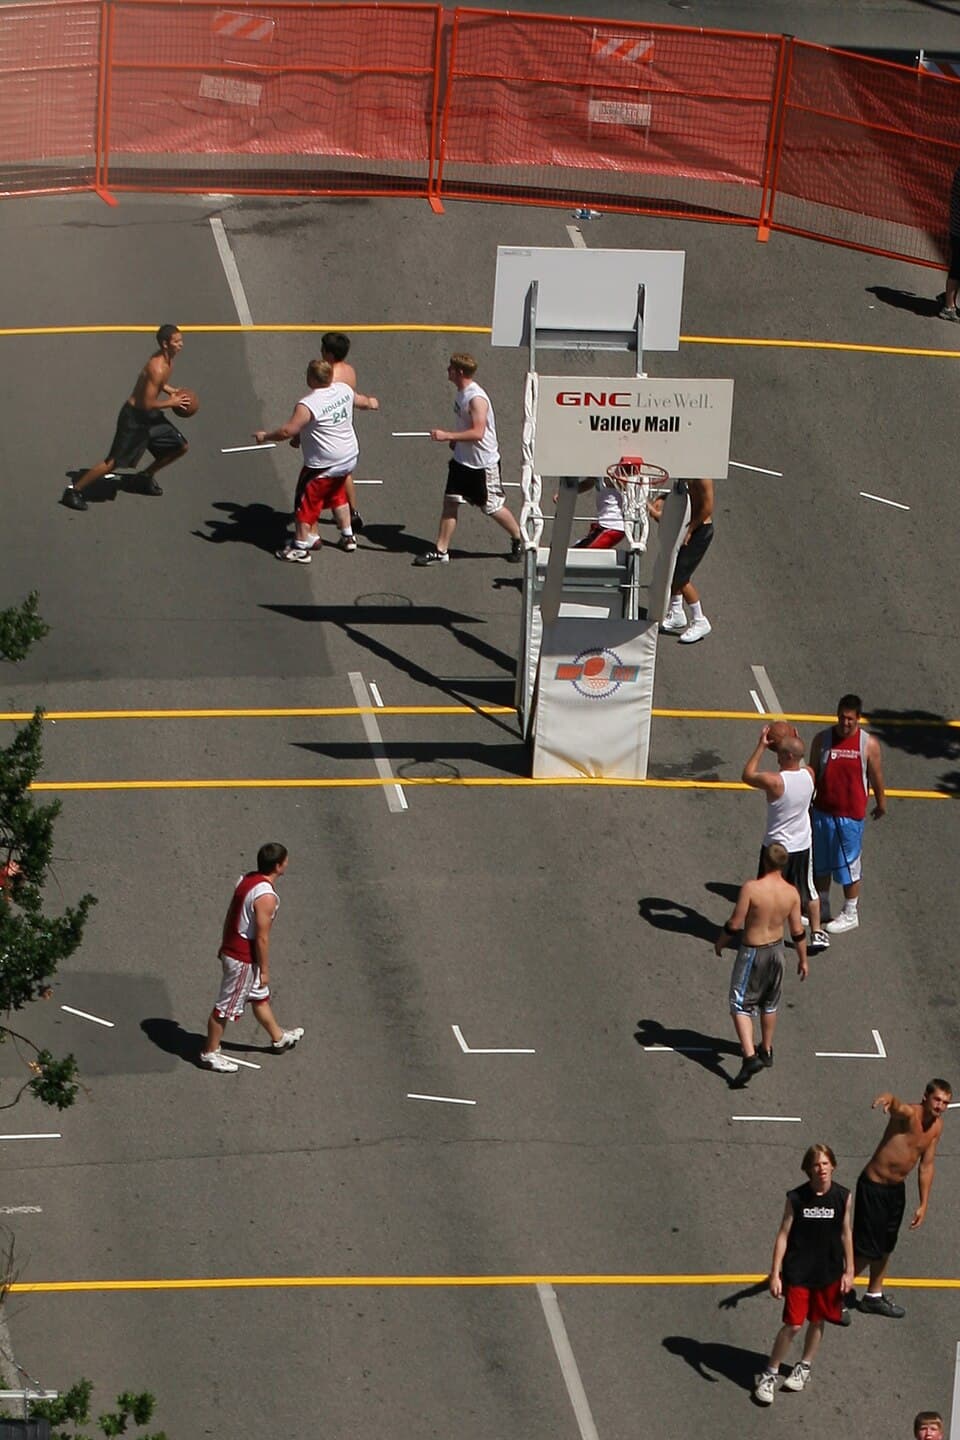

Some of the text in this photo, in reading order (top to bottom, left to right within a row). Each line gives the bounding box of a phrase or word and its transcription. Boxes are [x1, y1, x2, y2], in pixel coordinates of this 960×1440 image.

[555, 392, 631, 408] GNC
[333, 407, 348, 425] 24
[590, 416, 681, 433] Valley Mall
[803, 1207, 835, 1217] adidas
